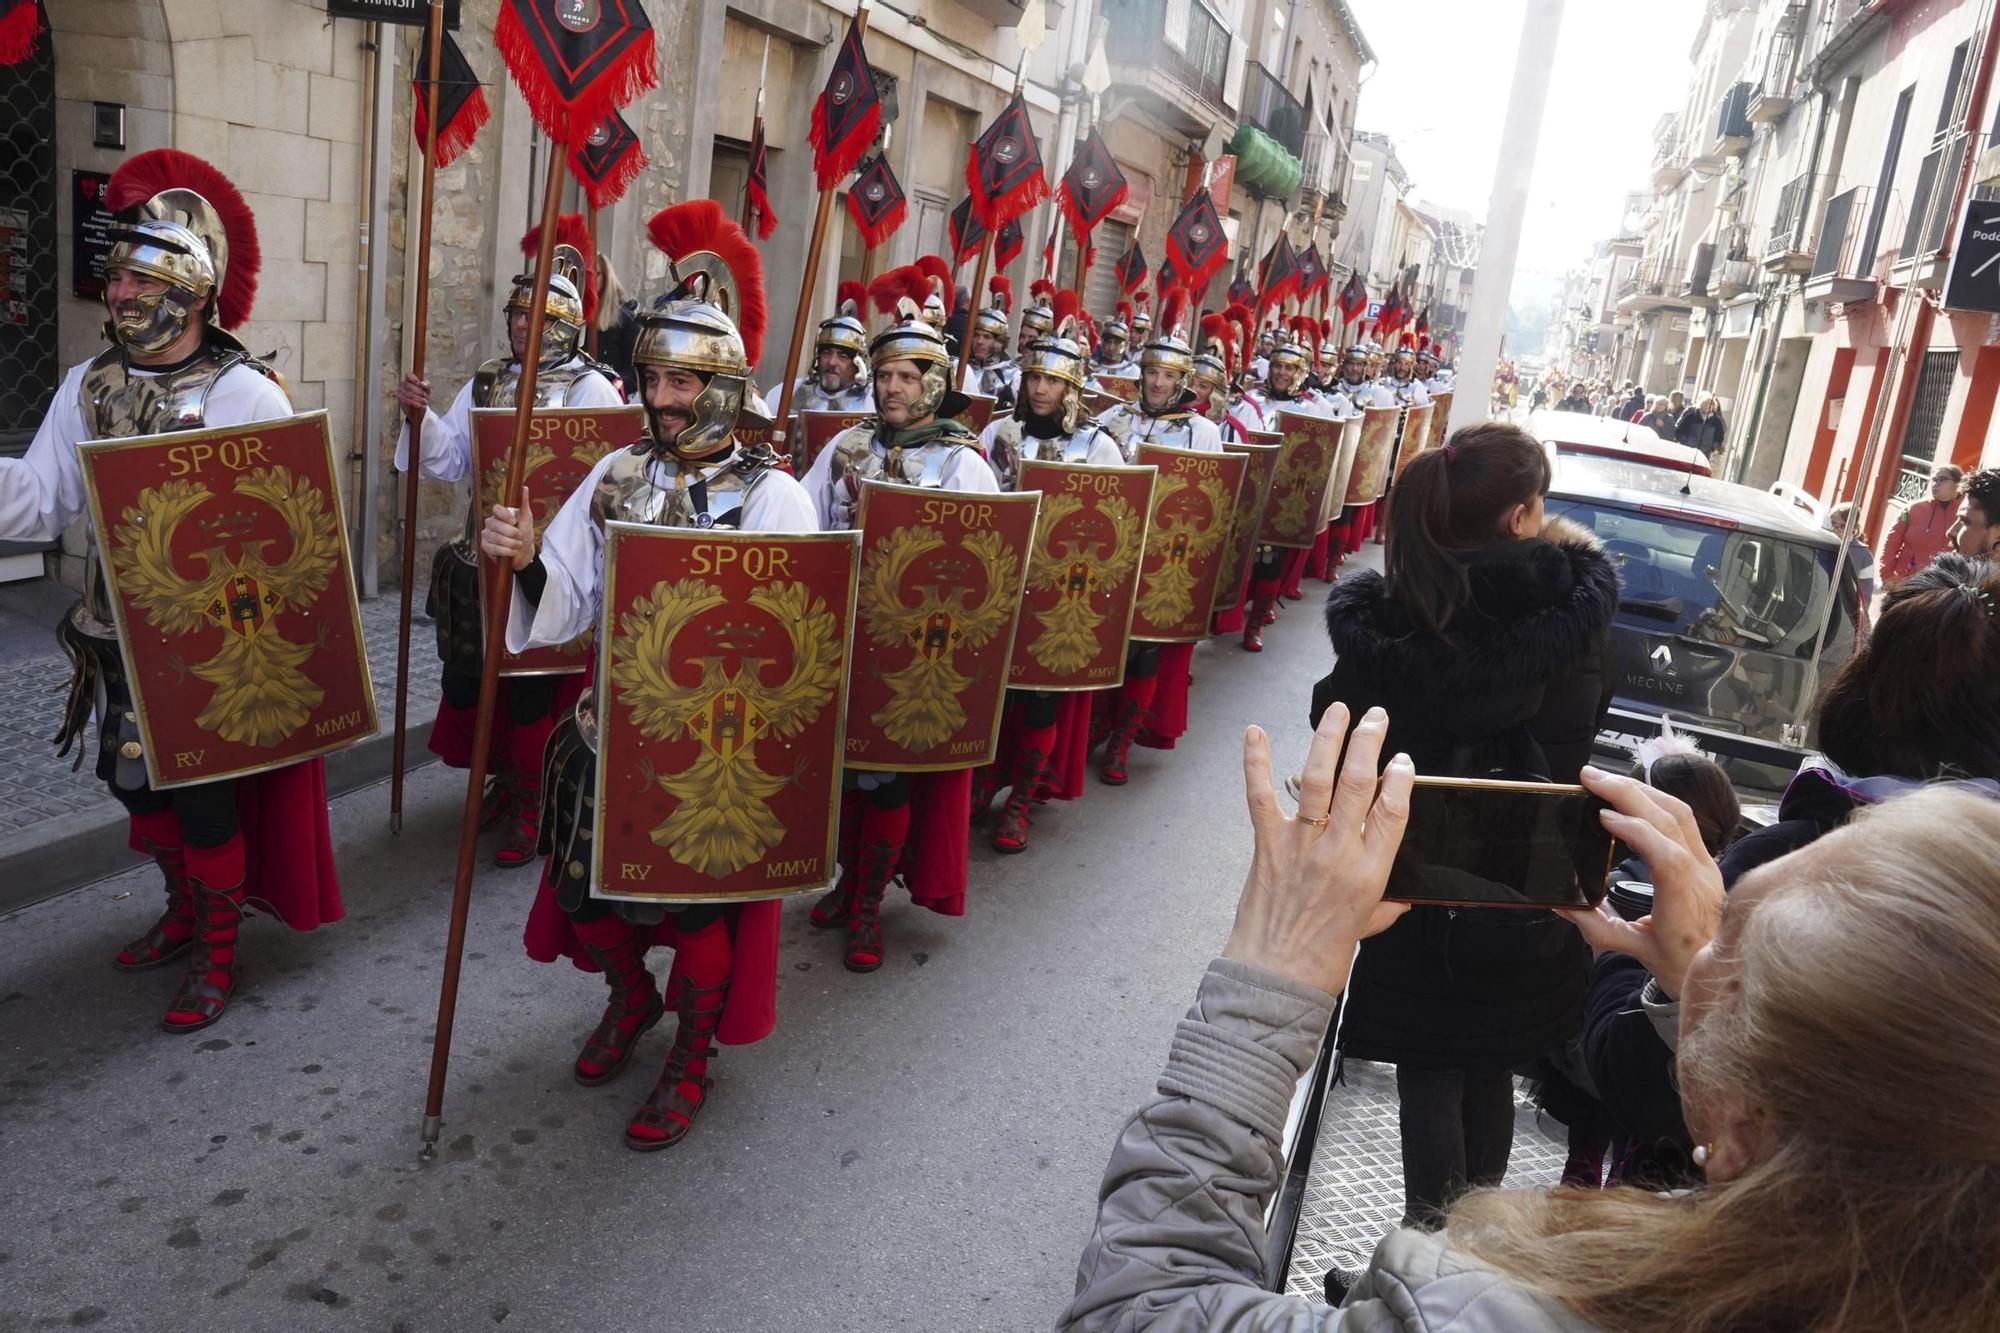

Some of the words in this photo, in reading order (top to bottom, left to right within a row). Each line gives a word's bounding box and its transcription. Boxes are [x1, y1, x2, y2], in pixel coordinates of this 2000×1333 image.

[529, 417, 600, 442] SPQR
[167, 437, 271, 477] SPQR
[1173, 456, 1220, 476] SPQR
[1065, 472, 1121, 495] SPQR
[921, 500, 993, 530] SPQR
[689, 544, 792, 580] SPQR
[174, 750, 205, 769] RV
[314, 710, 361, 737] MMVI
[950, 740, 985, 755] MMVI
[619, 863, 652, 881] RV
[766, 858, 817, 879] MMVI
